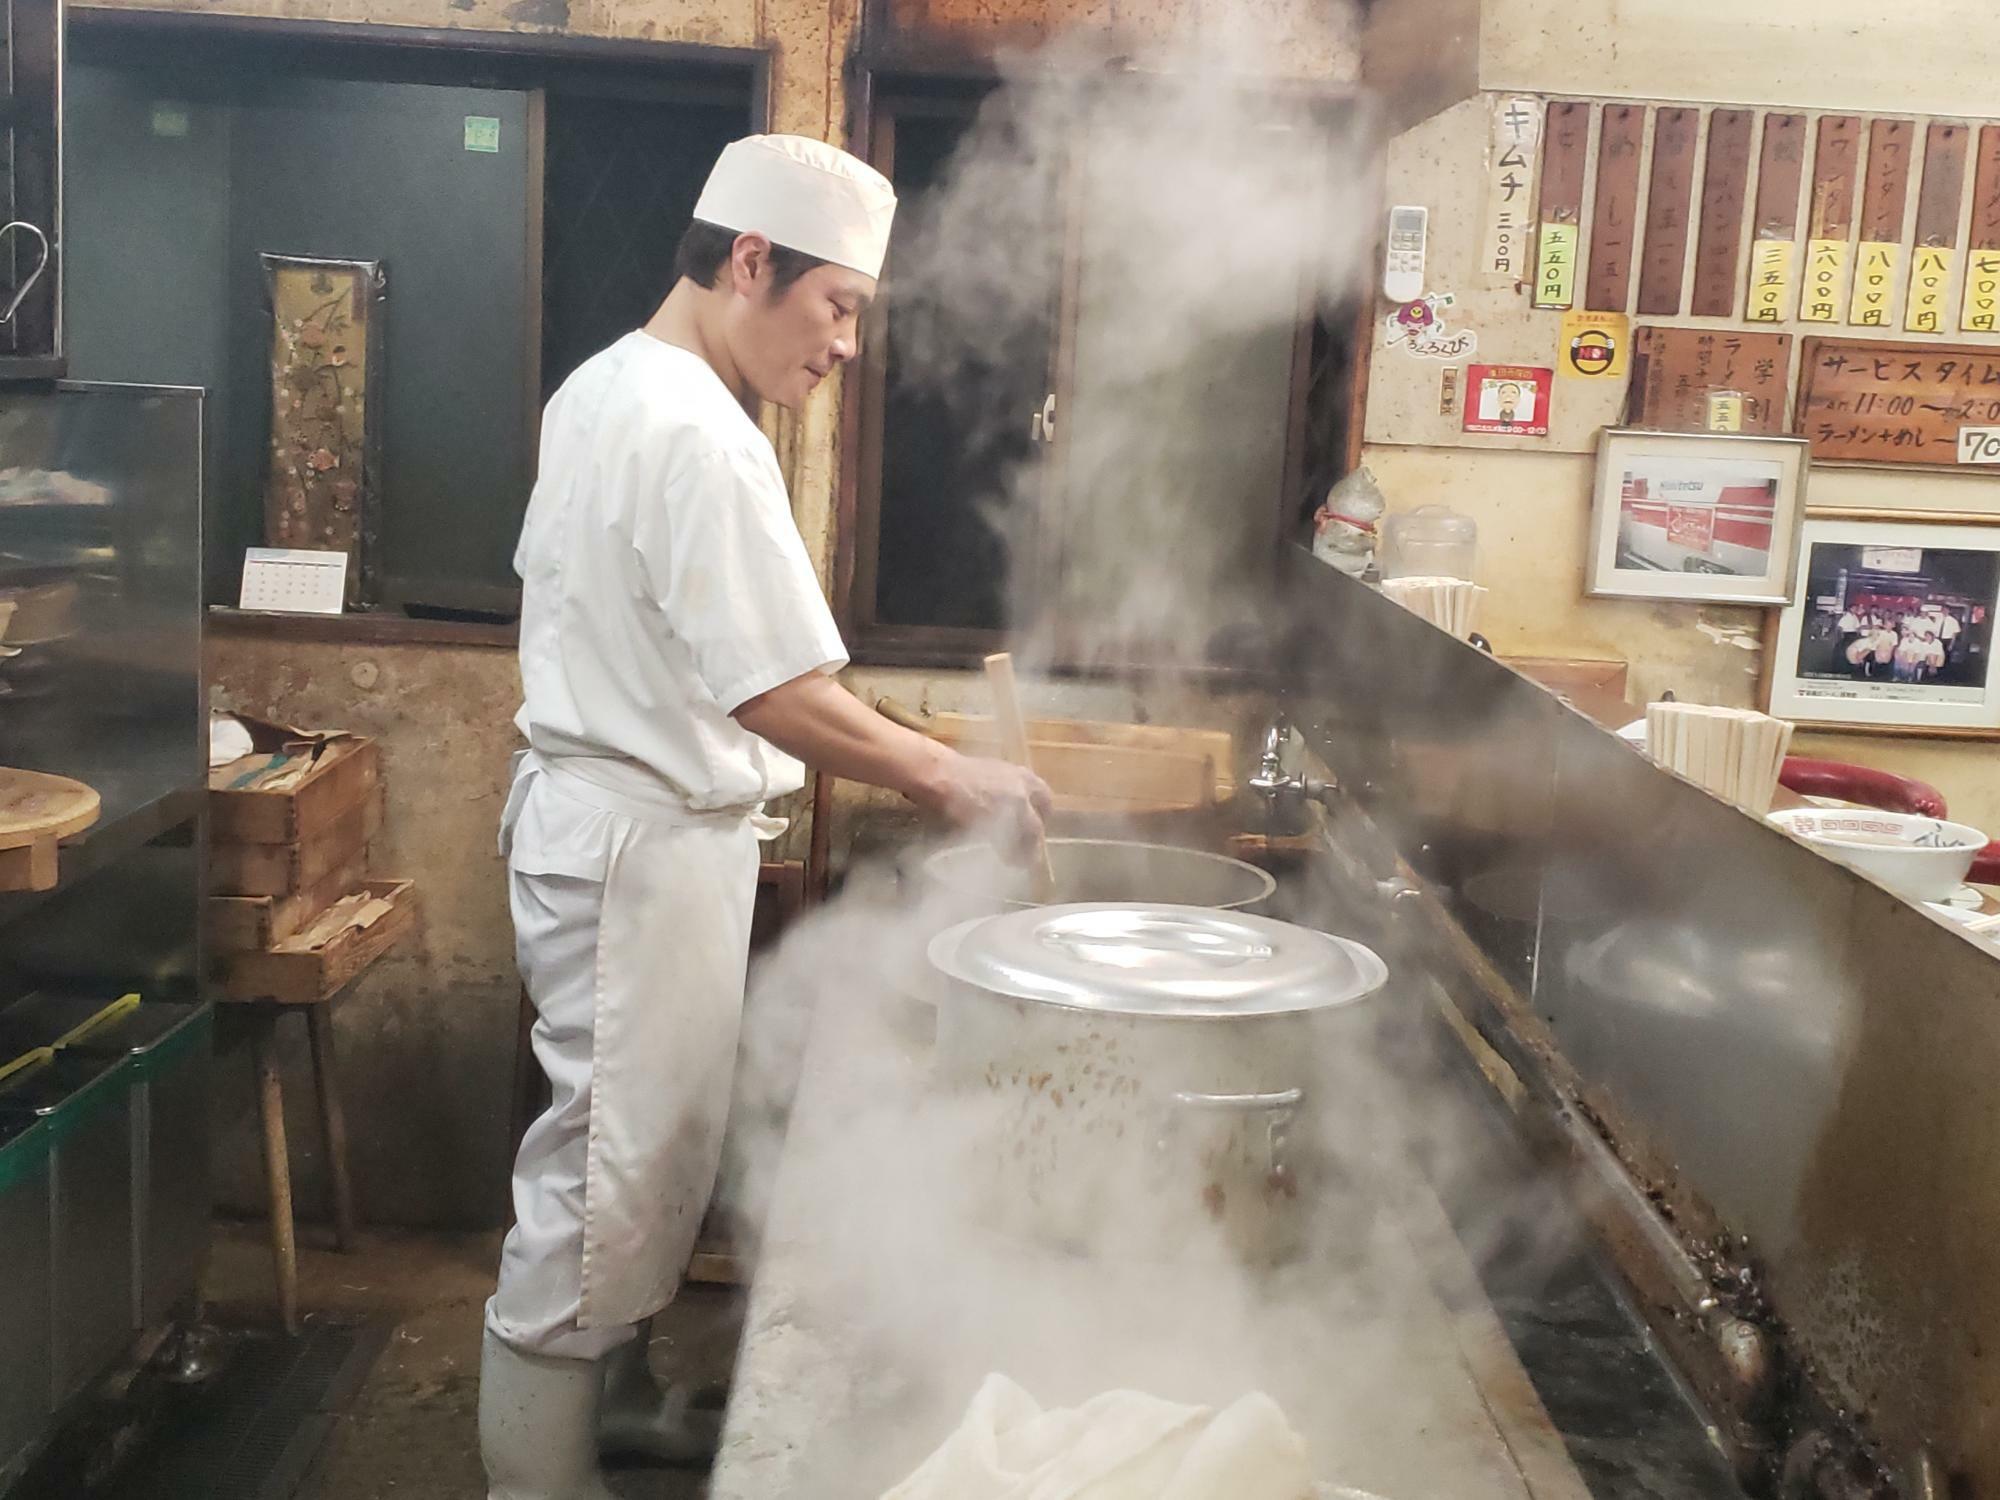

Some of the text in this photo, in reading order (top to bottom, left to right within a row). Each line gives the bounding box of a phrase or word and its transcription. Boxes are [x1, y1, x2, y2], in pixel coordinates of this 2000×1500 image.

[1498, 103, 1530, 202] キムチ
[1408, 336, 1470, 356] ろくろくび
[1855, 393, 1915, 416] 11:00
